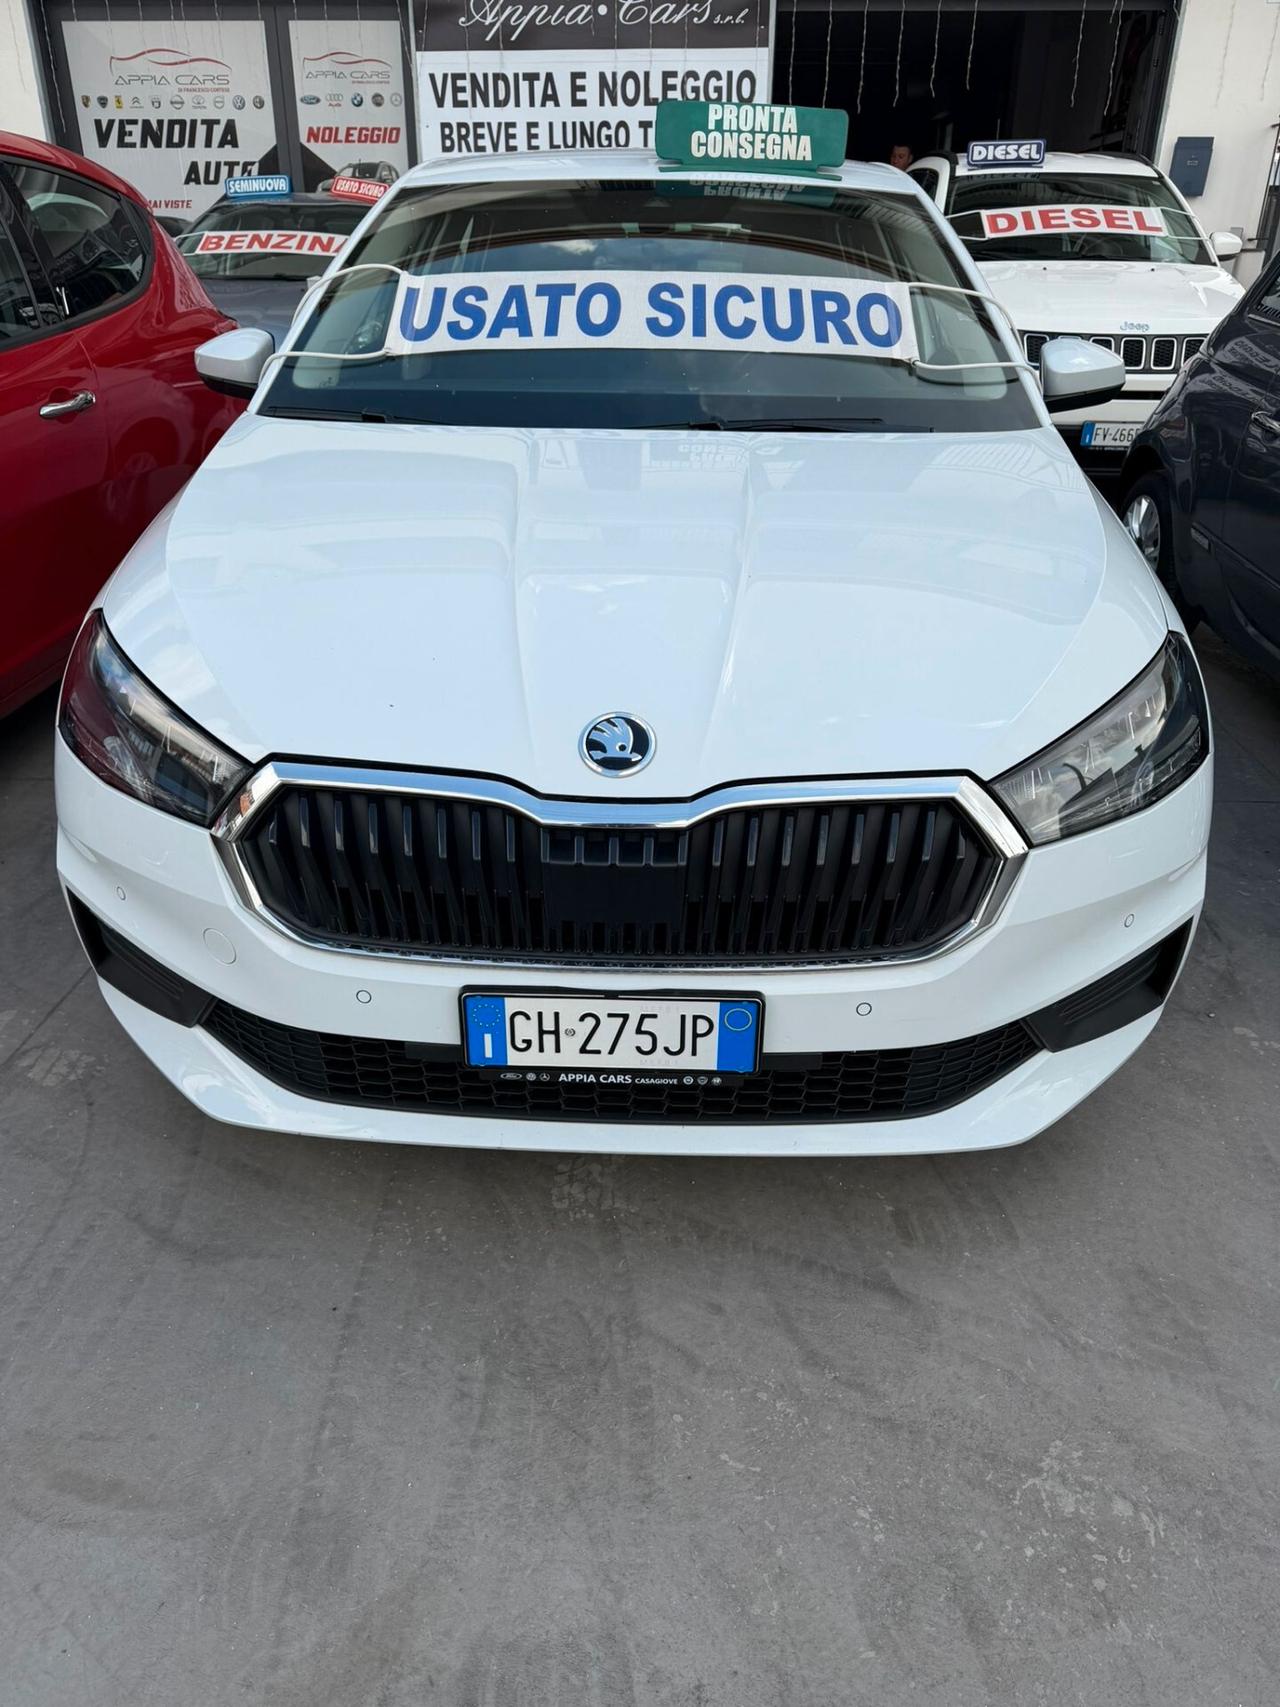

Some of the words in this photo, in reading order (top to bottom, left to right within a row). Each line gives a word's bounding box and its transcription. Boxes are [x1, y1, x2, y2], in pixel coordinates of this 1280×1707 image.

[114, 74, 171, 86] APPIA
[175, 74, 231, 86] CARS
[306, 70, 348, 79] APPIA
[350, 70, 391, 79] CARS
[429, 72, 562, 108] VENDITA
[570, 71, 588, 107] E
[599, 69, 758, 109] NOLEGGIO
[708, 103, 799, 133] PRONTA
[94, 118, 240, 149] VENDITA
[306, 126, 401, 144] NOLEGGIO
[440, 121, 519, 153] BREVE
[527, 121, 540, 151] E
[548, 120, 631, 149] LUNGO
[690, 130, 812, 161] CONSEGNA
[971, 143, 1041, 162] DIESEL
[183, 160, 259, 186] AUTO
[229, 178, 286, 193] SEMINUOVA
[336, 179, 359, 193] USATO
[358, 182, 385, 198] SICURO
[164, 199, 193, 209] VISTE
[986, 207, 1164, 234] DIESEL
[399, 283, 622, 342] USATO
[645, 284, 904, 348] SICURO
[1120, 321, 1150, 332] Jeep
[509, 1010, 561, 1053] GH
[578, 1012, 715, 1057] 275JP
[558, 1073, 597, 1083] APPIA
[600, 1074, 632, 1084] CARS
[635, 1077, 678, 1085] CASAGIOVE
